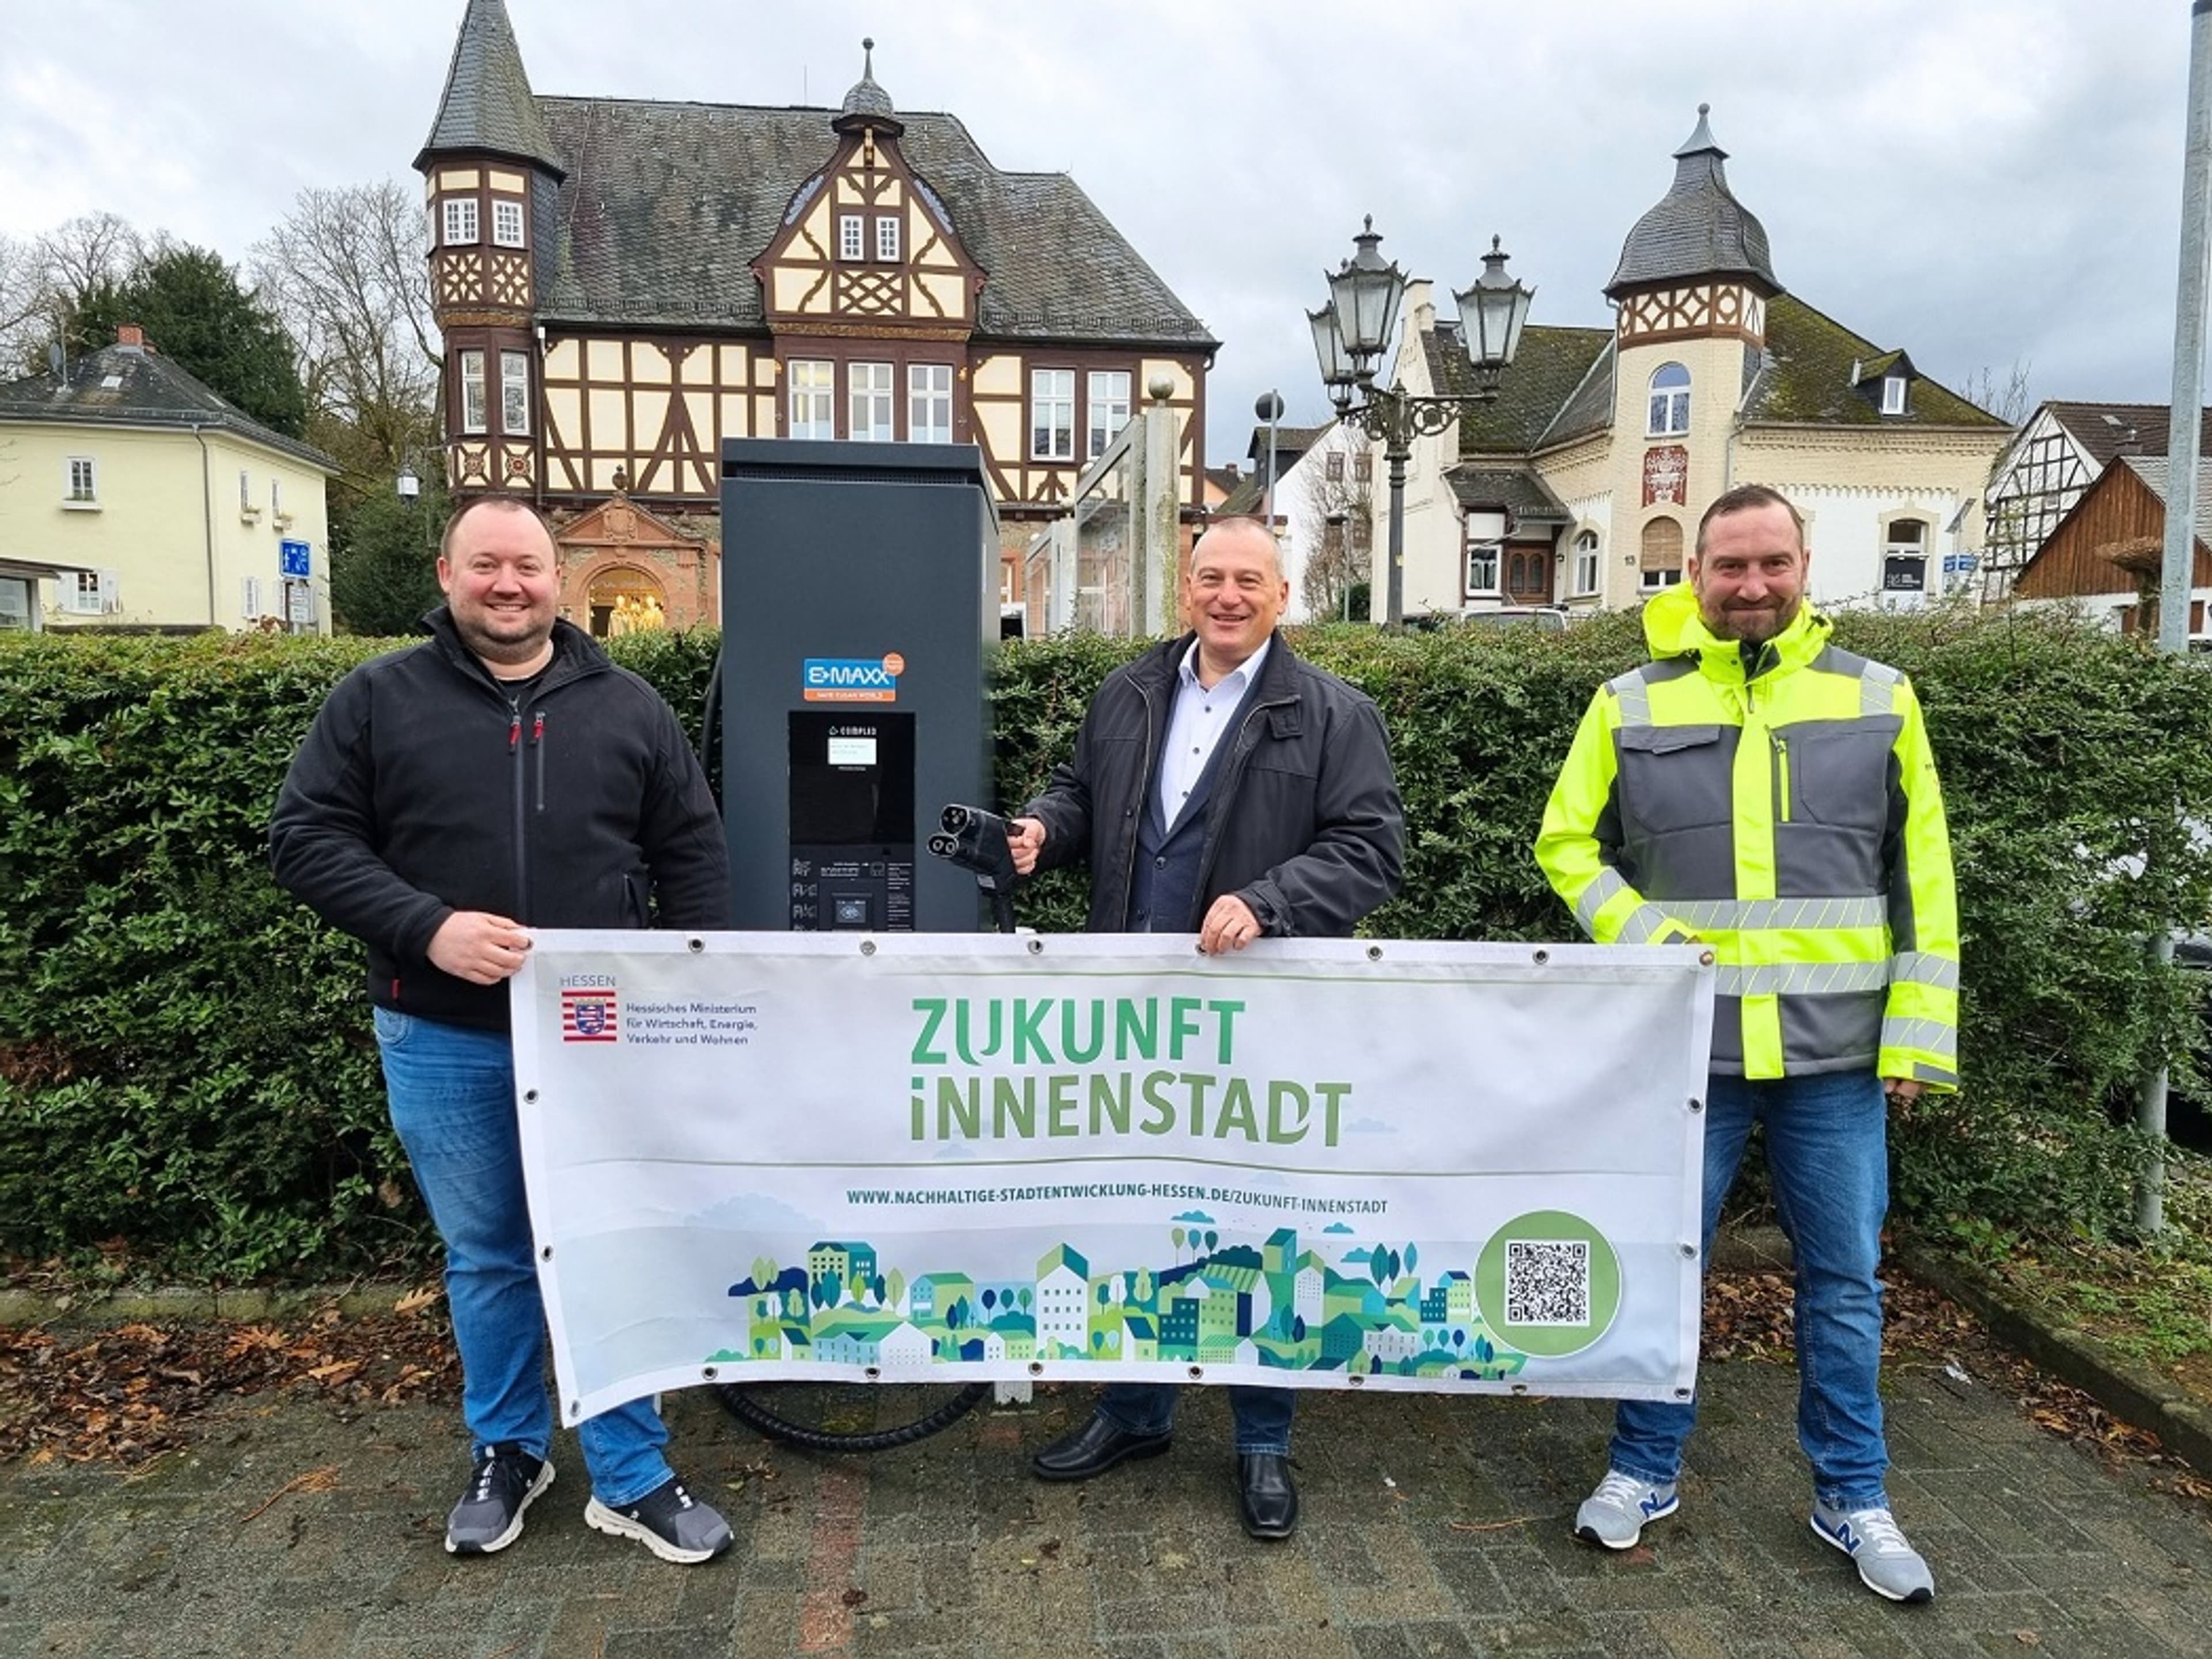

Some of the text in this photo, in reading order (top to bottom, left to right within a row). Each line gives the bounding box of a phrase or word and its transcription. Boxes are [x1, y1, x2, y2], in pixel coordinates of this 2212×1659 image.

[560, 975, 616, 987] HESSEN
[626, 1002, 757, 1014] Hessisches Ministerium
[626, 1017, 758, 1031] für Wirtschaft, Energie,
[911, 997, 1245, 1066] ZUKUNFT
[627, 1033, 748, 1046] Verkehr und Wohnen
[847, 1183, 1387, 1214] WWW.NACHHALTIGE-STADTENTWICKLUNG-HESSEN.DE/ZUKUNFT-INNENSTADT
